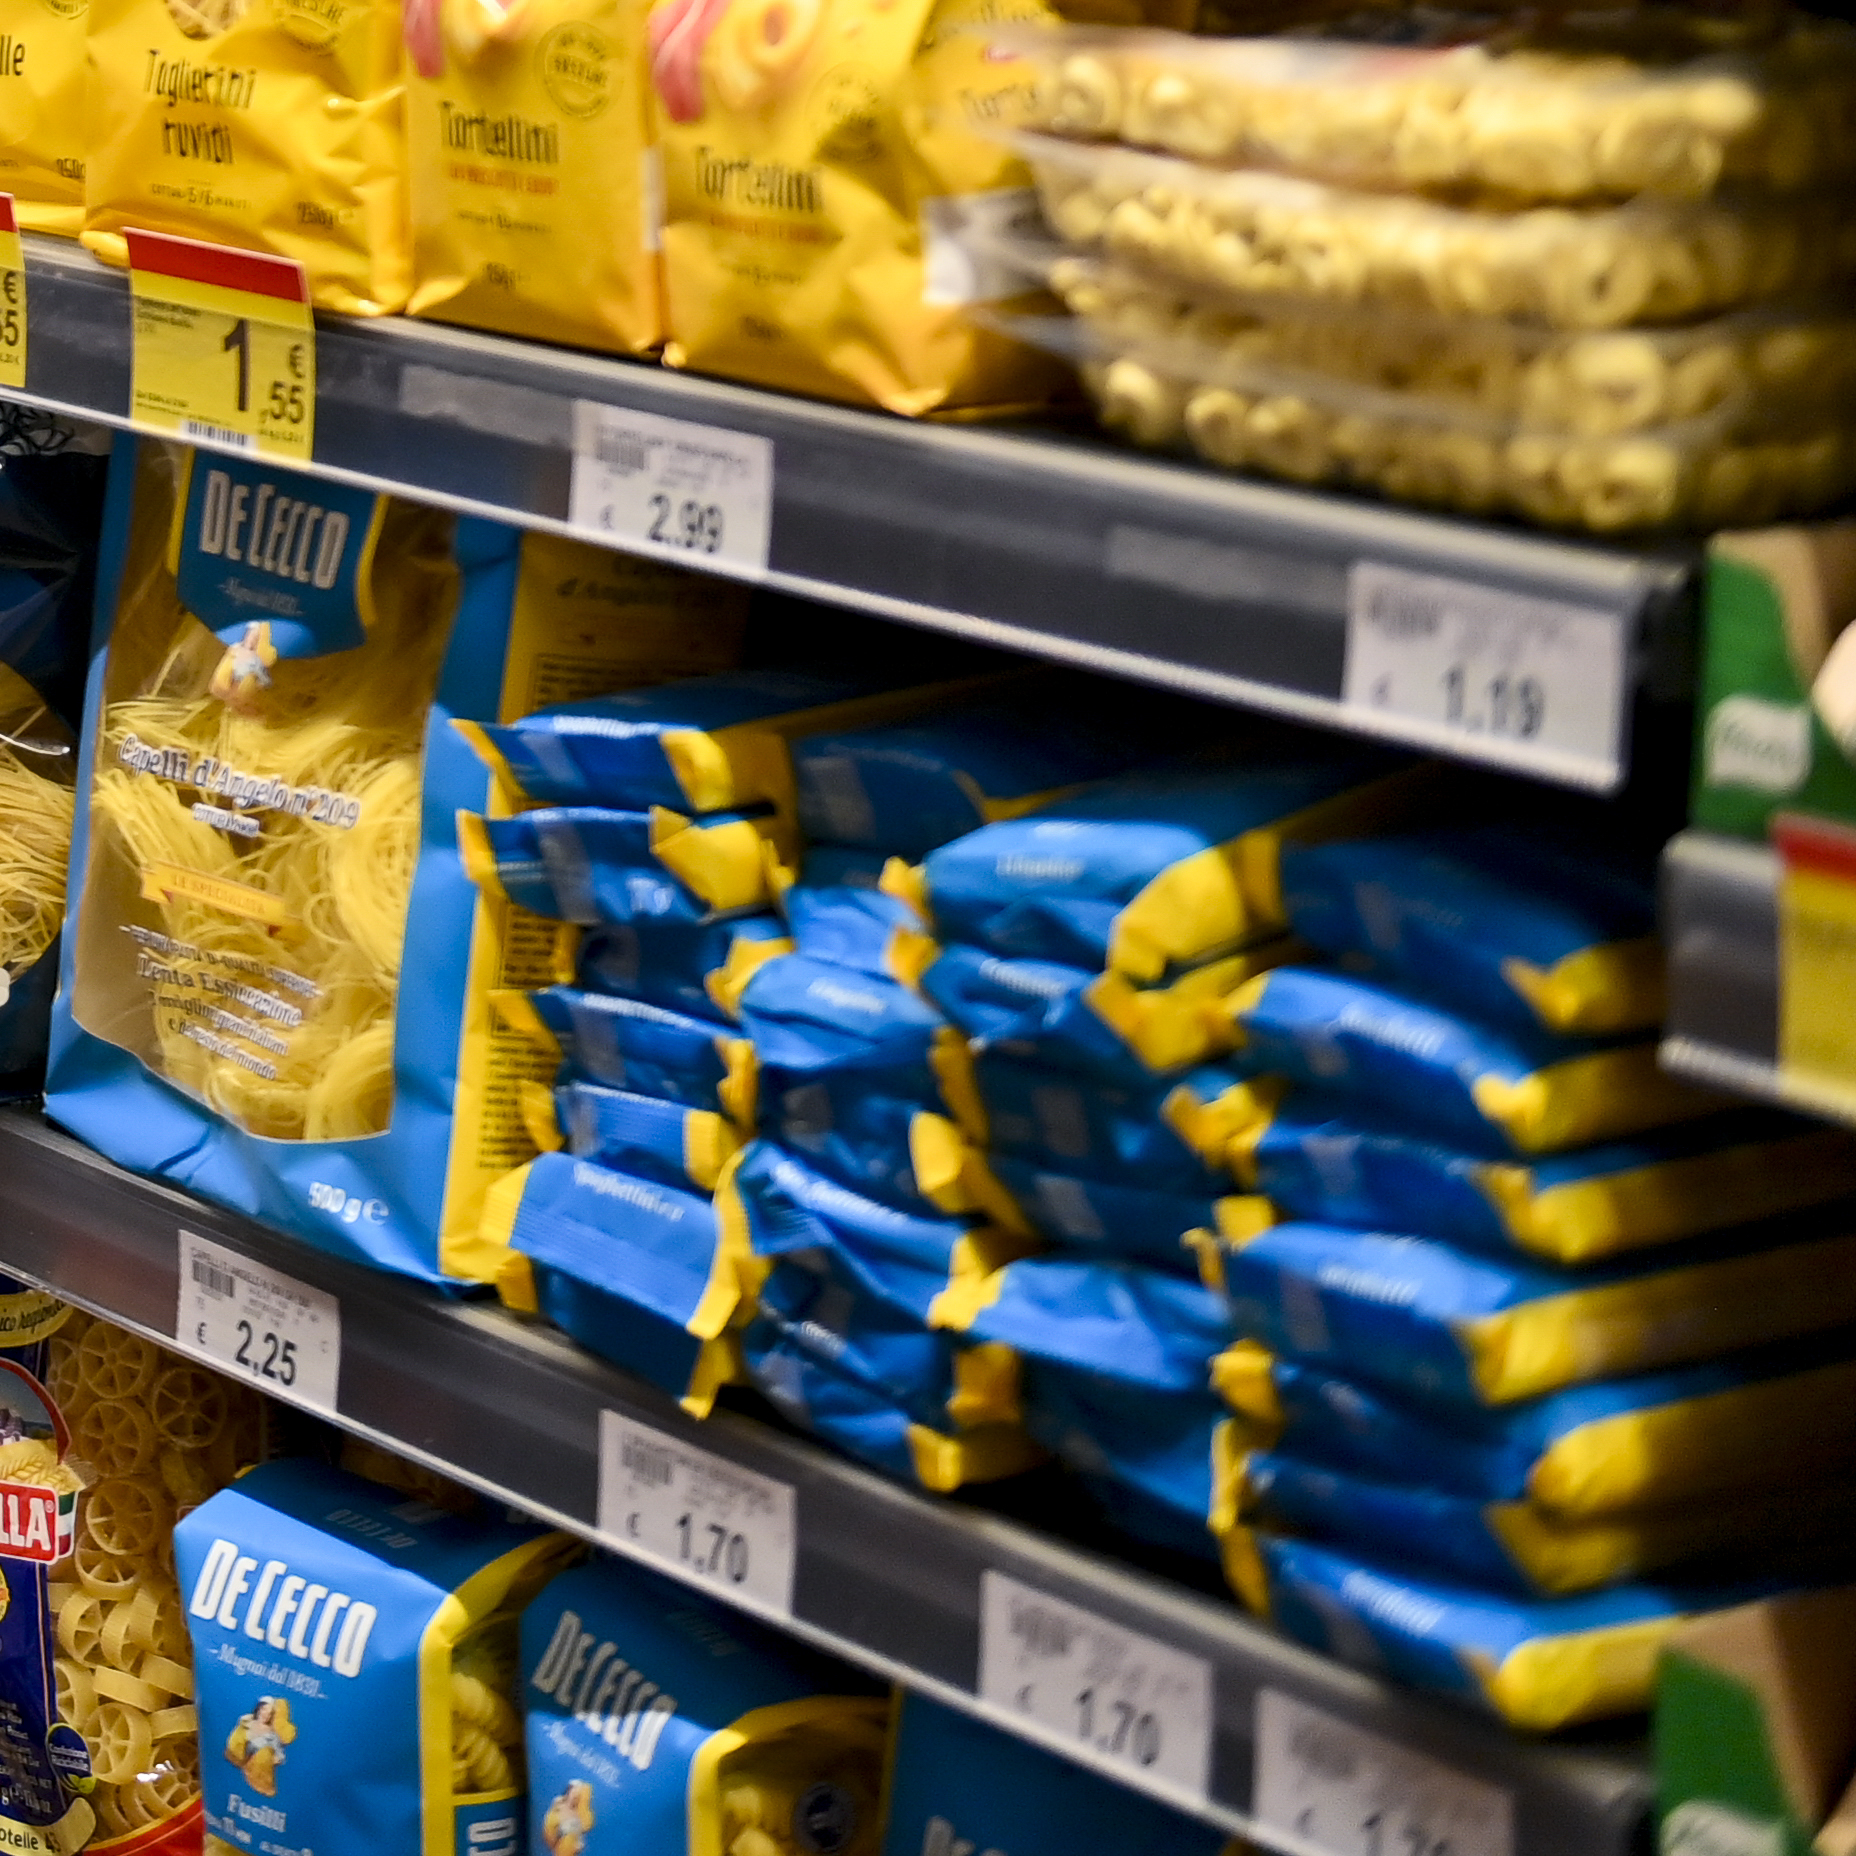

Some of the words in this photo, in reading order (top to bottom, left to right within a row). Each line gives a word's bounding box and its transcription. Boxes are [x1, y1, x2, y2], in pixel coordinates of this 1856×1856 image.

[144, 49, 257, 110] Taglierini
[162, 117, 235, 164] ruvidi
[224, 318, 251, 413] 1
[198, 469, 250, 561] DE
[247, 483, 350, 590] CECCO
[118, 732, 188, 783] Capelli
[193, 756, 287, 812] d'Angelo
[235, 1319, 298, 1387] 2,25
[189, 1537, 259, 1632] DE
[243, 1558, 379, 1679] CECCO
[531, 1610, 592, 1707] DE
[574, 1640, 679, 1771] CECCO
[227, 1792, 288, 1834] Fusilli
